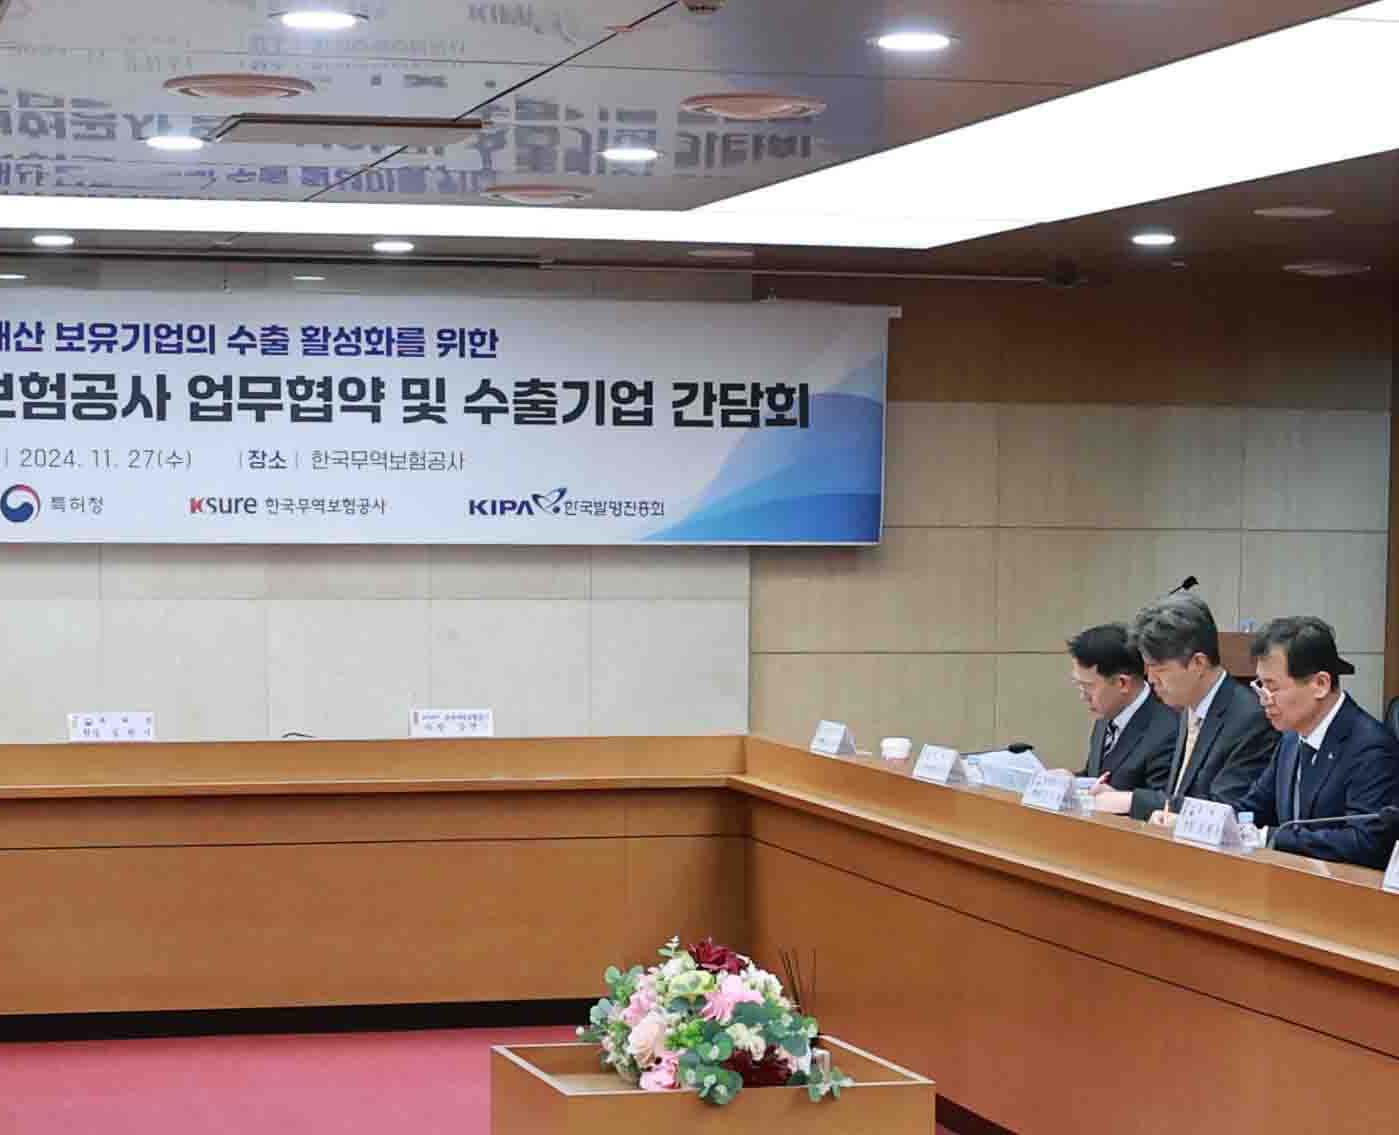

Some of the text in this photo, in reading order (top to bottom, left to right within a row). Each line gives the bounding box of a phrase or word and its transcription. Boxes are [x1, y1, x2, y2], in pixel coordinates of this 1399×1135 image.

[55, 321, 216, 355] 보유기업의
[226, 324, 289, 356] 수출
[301, 325, 426, 358] 활성화를
[436, 327, 499, 359] 위한
[188, 374, 385, 425] 업무협약
[401, 376, 448, 425] 및
[463, 378, 654, 427] 수출기업
[671, 381, 811, 430] 간담회
[19, 448, 81, 468] 2024.
[127, 448, 192, 470] 27(수)
[247, 449, 465, 472] 장소 한국무역보험공사
[50, 495, 104, 515] 특허청
[265, 496, 386, 516] 한국무역보험공사
[468, 499, 535, 516] KIPA
